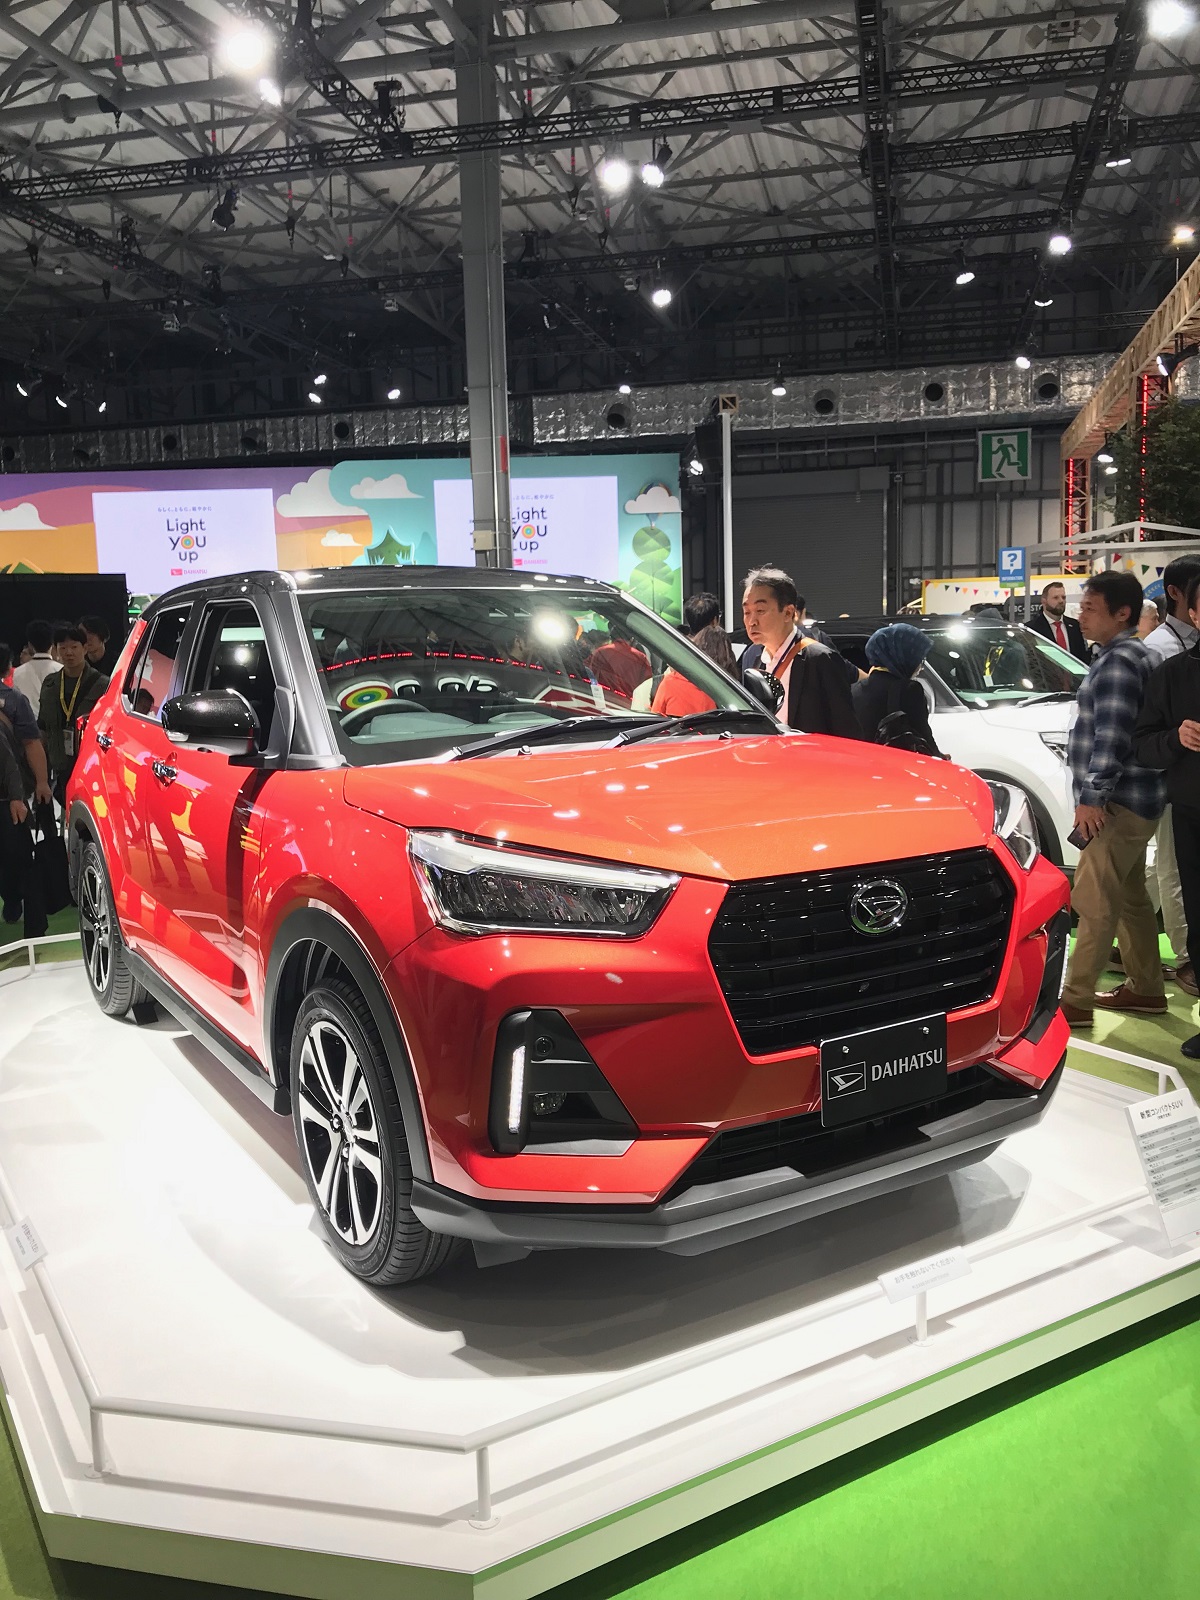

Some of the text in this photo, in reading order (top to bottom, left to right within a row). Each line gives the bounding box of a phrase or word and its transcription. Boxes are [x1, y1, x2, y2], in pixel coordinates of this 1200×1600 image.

[512, 507, 548, 523] ight
[166, 518, 206, 534] Light
[520, 541, 539, 553] up
[178, 551, 198, 563] up
[871, 1047, 943, 1081] DAIHATSU
